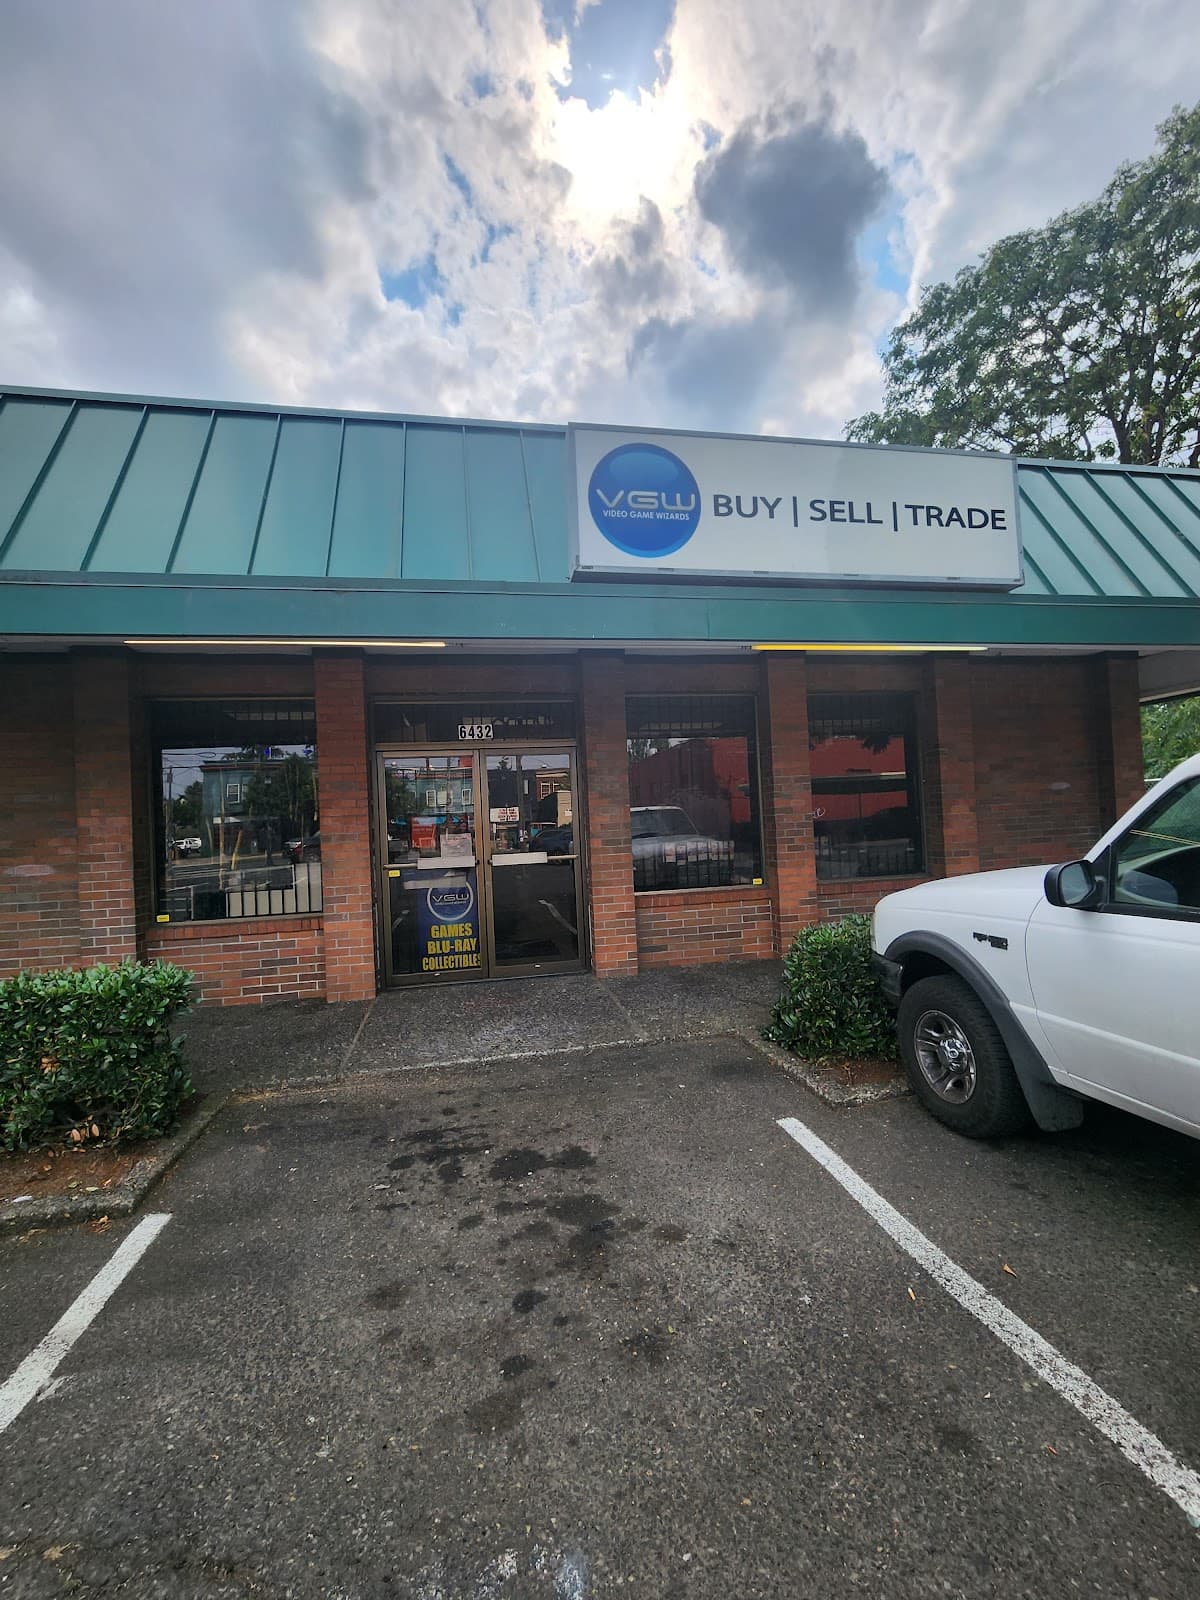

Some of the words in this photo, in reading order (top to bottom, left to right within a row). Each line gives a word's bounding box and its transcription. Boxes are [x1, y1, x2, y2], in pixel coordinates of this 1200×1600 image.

[596, 488, 696, 511] VGW
[630, 511, 654, 519] GAME
[656, 512, 690, 521] WIZARDS
[713, 494, 782, 519] BUY
[809, 499, 883, 524] SELL
[904, 504, 1007, 531] TRADE
[459, 725, 492, 739] 6432
[432, 894, 470, 902] VGW
[430, 923, 473, 938] GAMES
[427, 938, 477, 954] BLU-RAY
